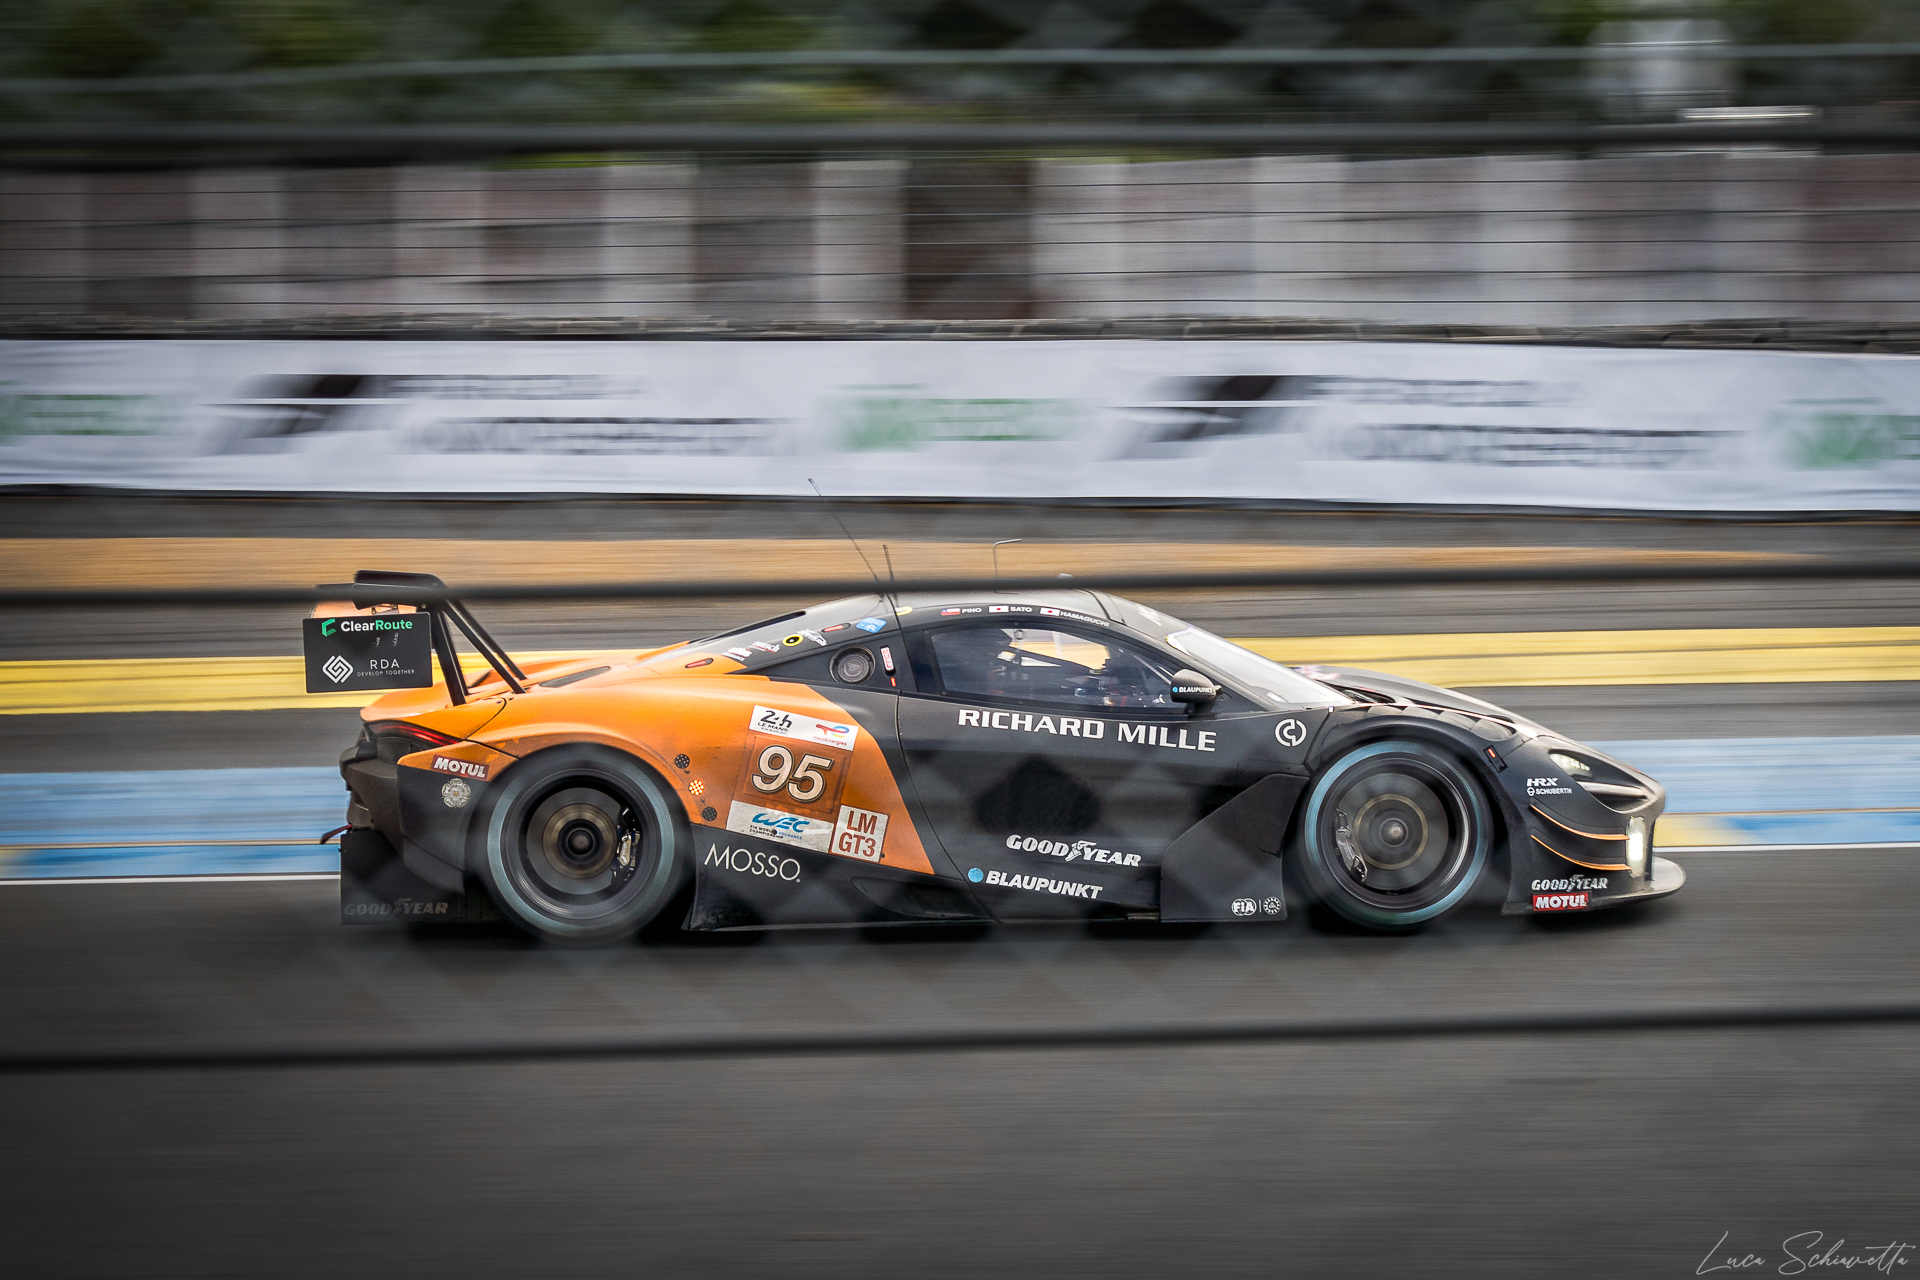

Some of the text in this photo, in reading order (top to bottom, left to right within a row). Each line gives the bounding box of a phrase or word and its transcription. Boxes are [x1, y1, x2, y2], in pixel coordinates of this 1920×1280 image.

[340, 619, 413, 632] ClearRoute
[1060, 611, 1110, 627] HAMAGUCHI
[370, 658, 400, 670] RDA
[957, 708, 1217, 752] RICHARD MILLE
[434, 757, 486, 778] MOTUL
[751, 744, 834, 803] 95
[1526, 777, 1559, 787] HRX
[752, 813, 810, 833] WEC
[846, 810, 878, 835] LM
[838, 832, 876, 857] GT3
[1005, 834, 1141, 867] GOODYEAR
[985, 870, 1103, 900] BLAUPUNKT
[1531, 874, 1608, 892] GOODYEAR
[343, 899, 448, 916] GOODYEAR
[1232, 901, 1255, 912] FIA
[1535, 894, 1588, 909] MOTUL
